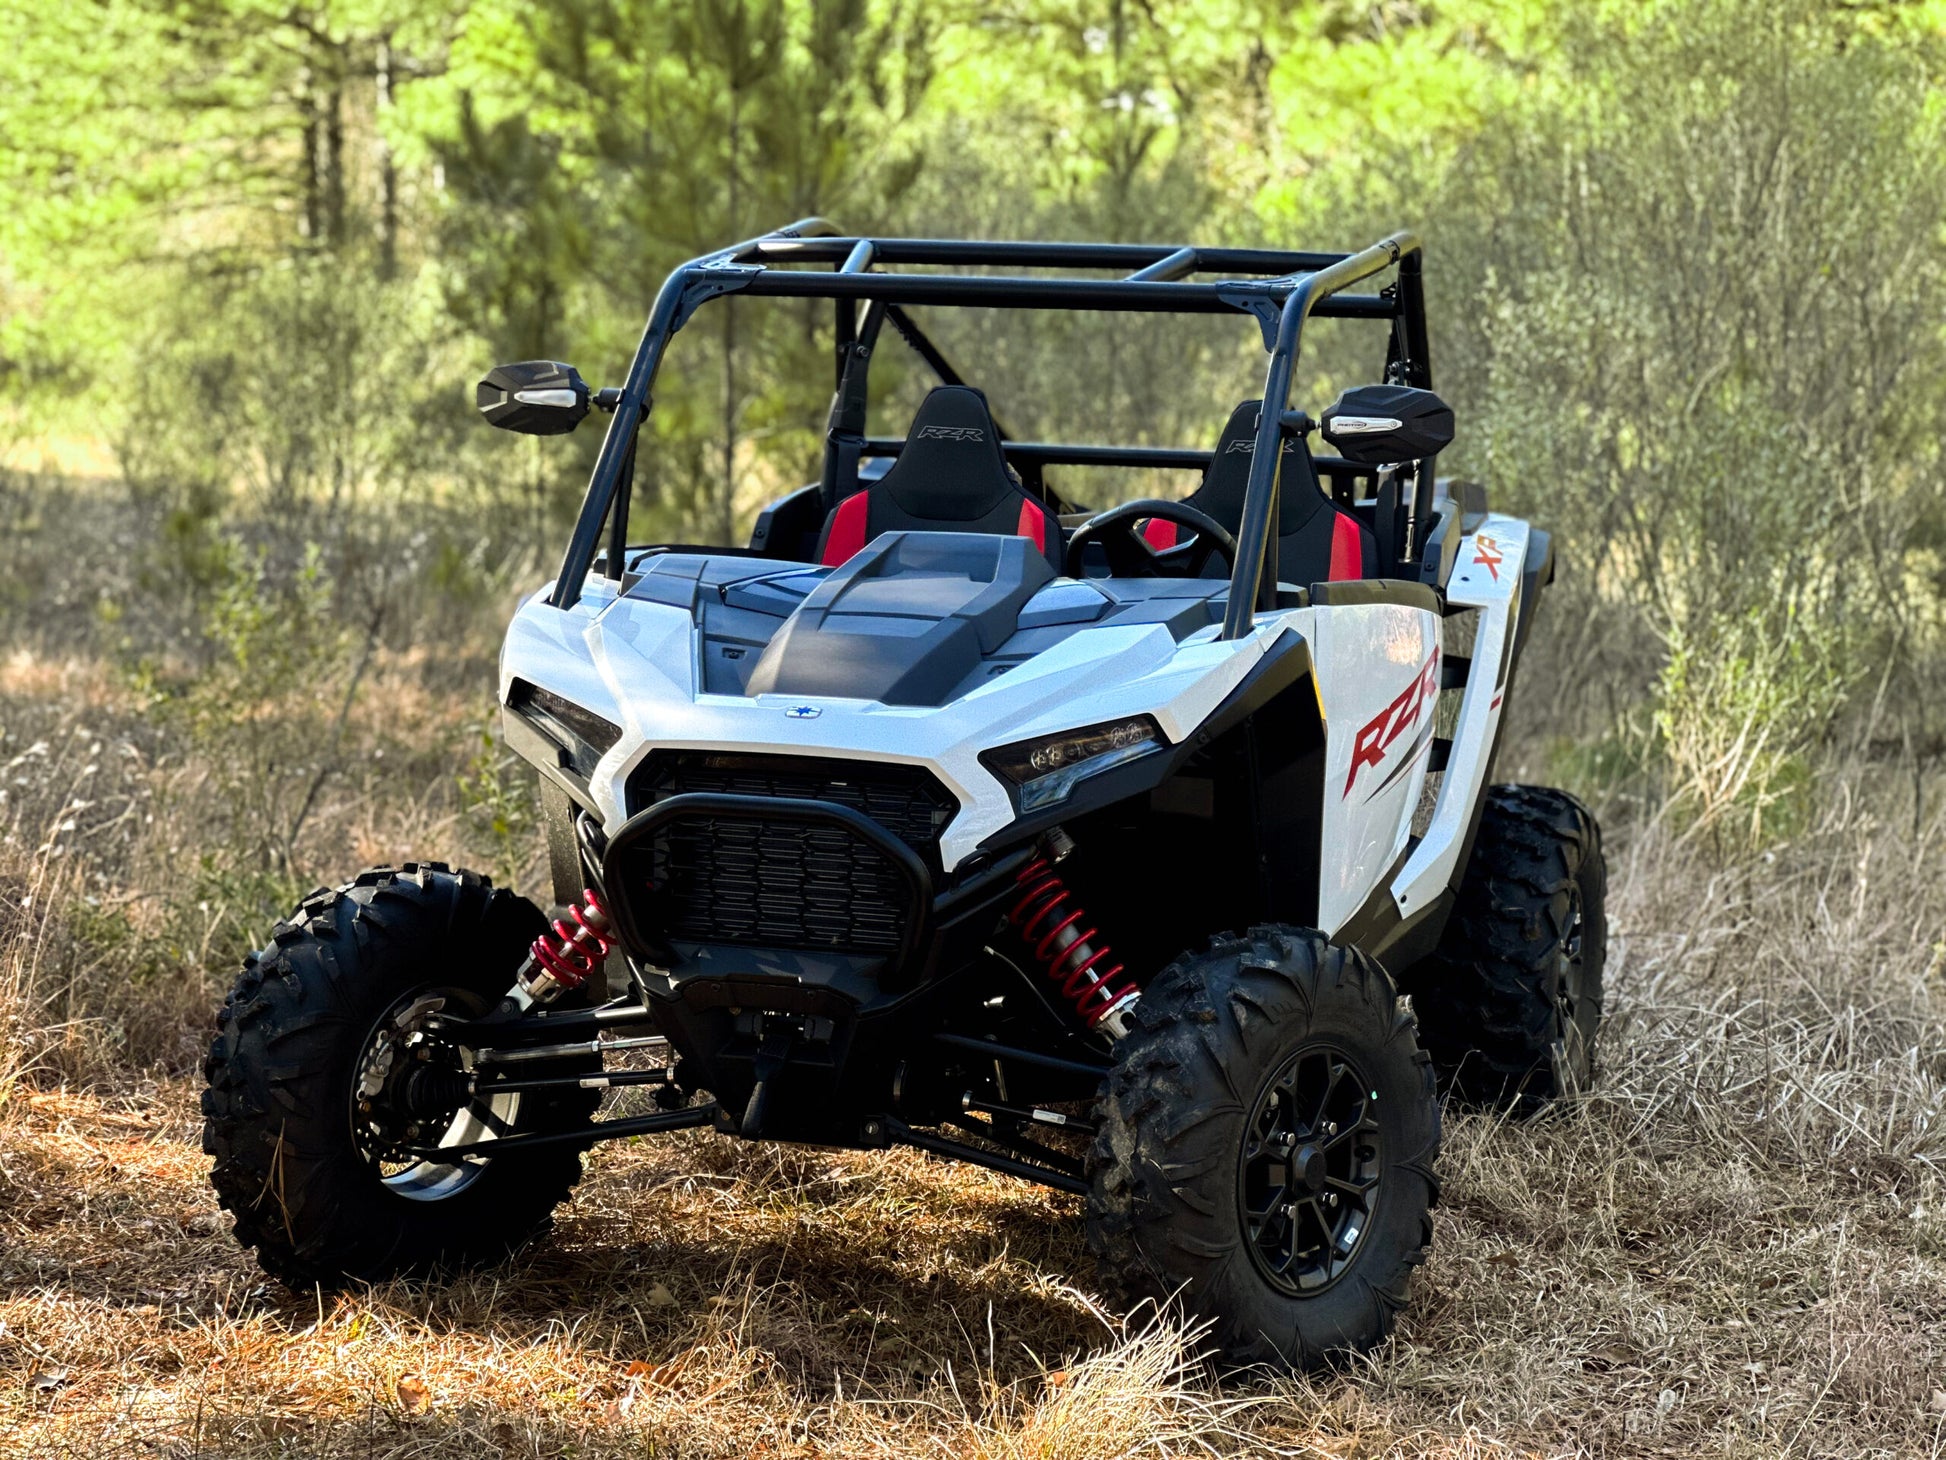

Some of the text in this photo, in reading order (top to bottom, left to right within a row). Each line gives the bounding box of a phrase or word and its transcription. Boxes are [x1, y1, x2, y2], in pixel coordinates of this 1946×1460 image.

[917, 425, 984, 442] RZR
[1473, 534, 1504, 583] XP
[1341, 643, 1440, 802] RZR
